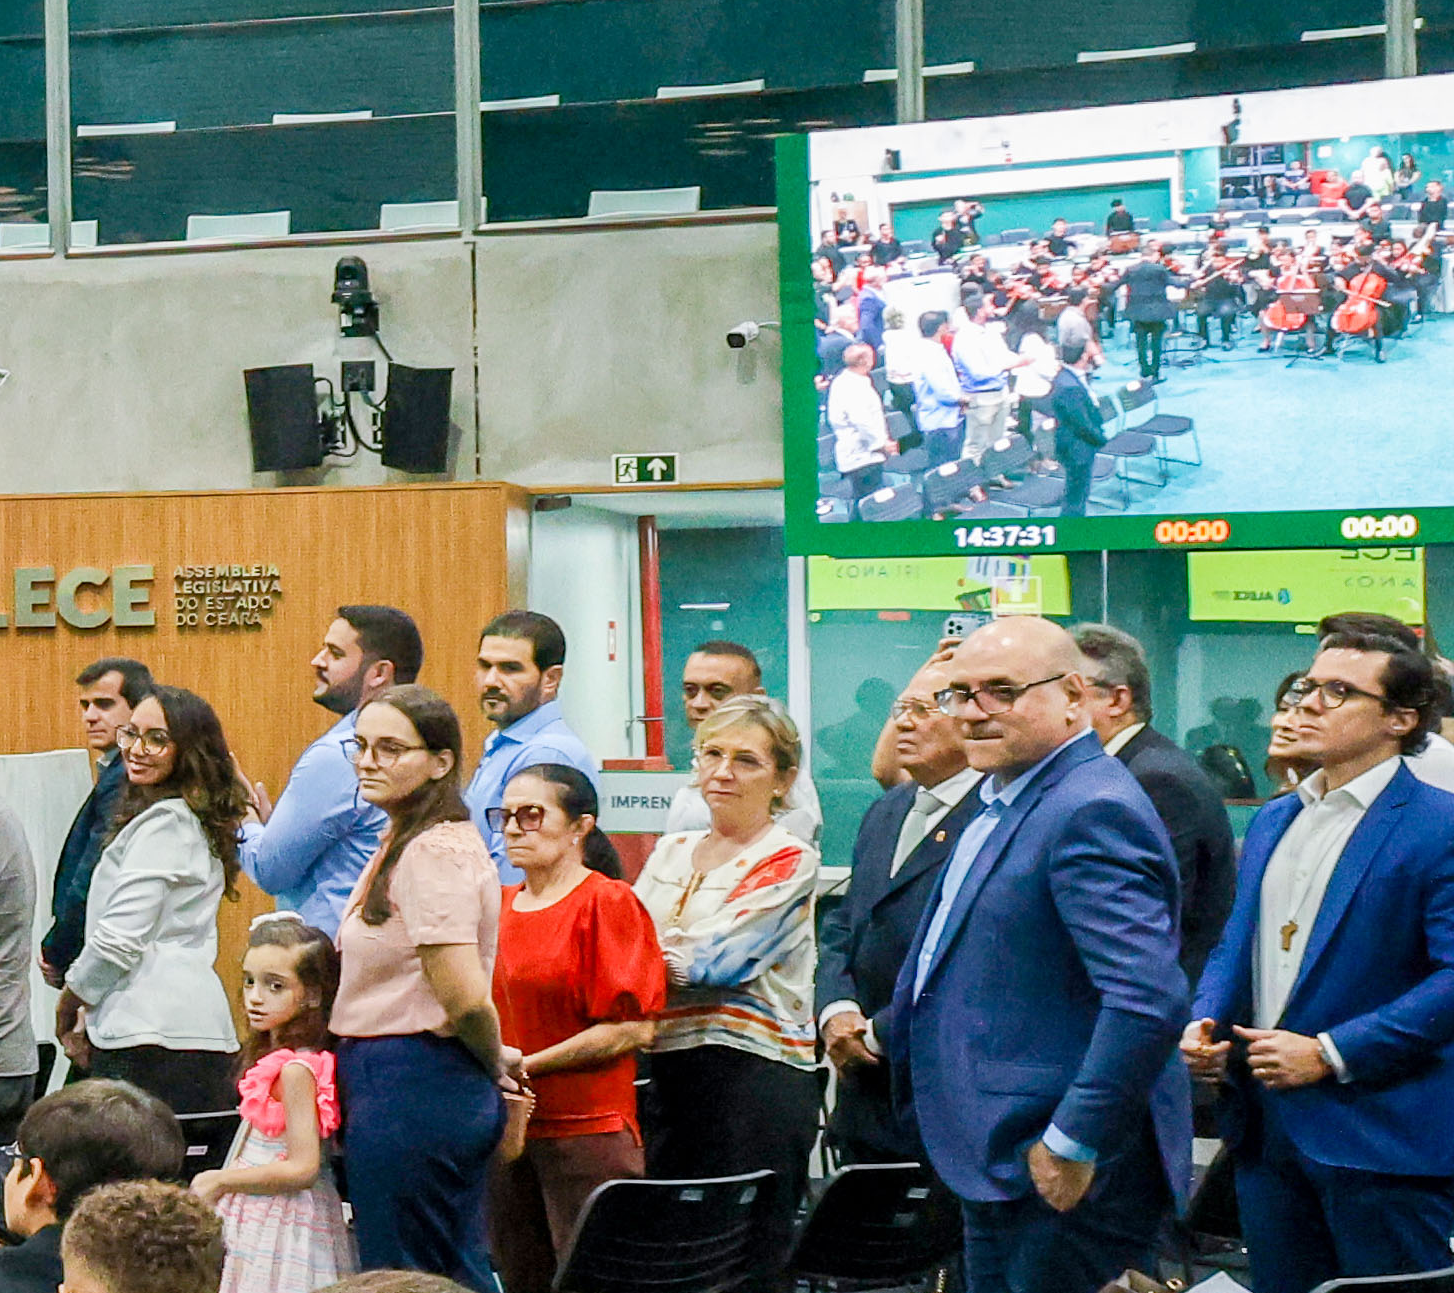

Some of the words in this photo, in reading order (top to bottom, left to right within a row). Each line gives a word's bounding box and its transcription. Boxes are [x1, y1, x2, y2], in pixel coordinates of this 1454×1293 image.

[1155, 519, 1231, 544] 00:00
[1340, 514, 1419, 540] 00:00
[953, 524, 1057, 548] 14:37:31
[174, 564, 281, 578] ASSEMBLEIA
[174, 579, 283, 594] LEGISLATIVA
[176, 596, 198, 610] DO
[205, 595, 273, 610] ESTADO
[176, 612, 198, 626] DO
[204, 609, 262, 626] CEARÁ
[611, 795, 672, 809] IMPREN
